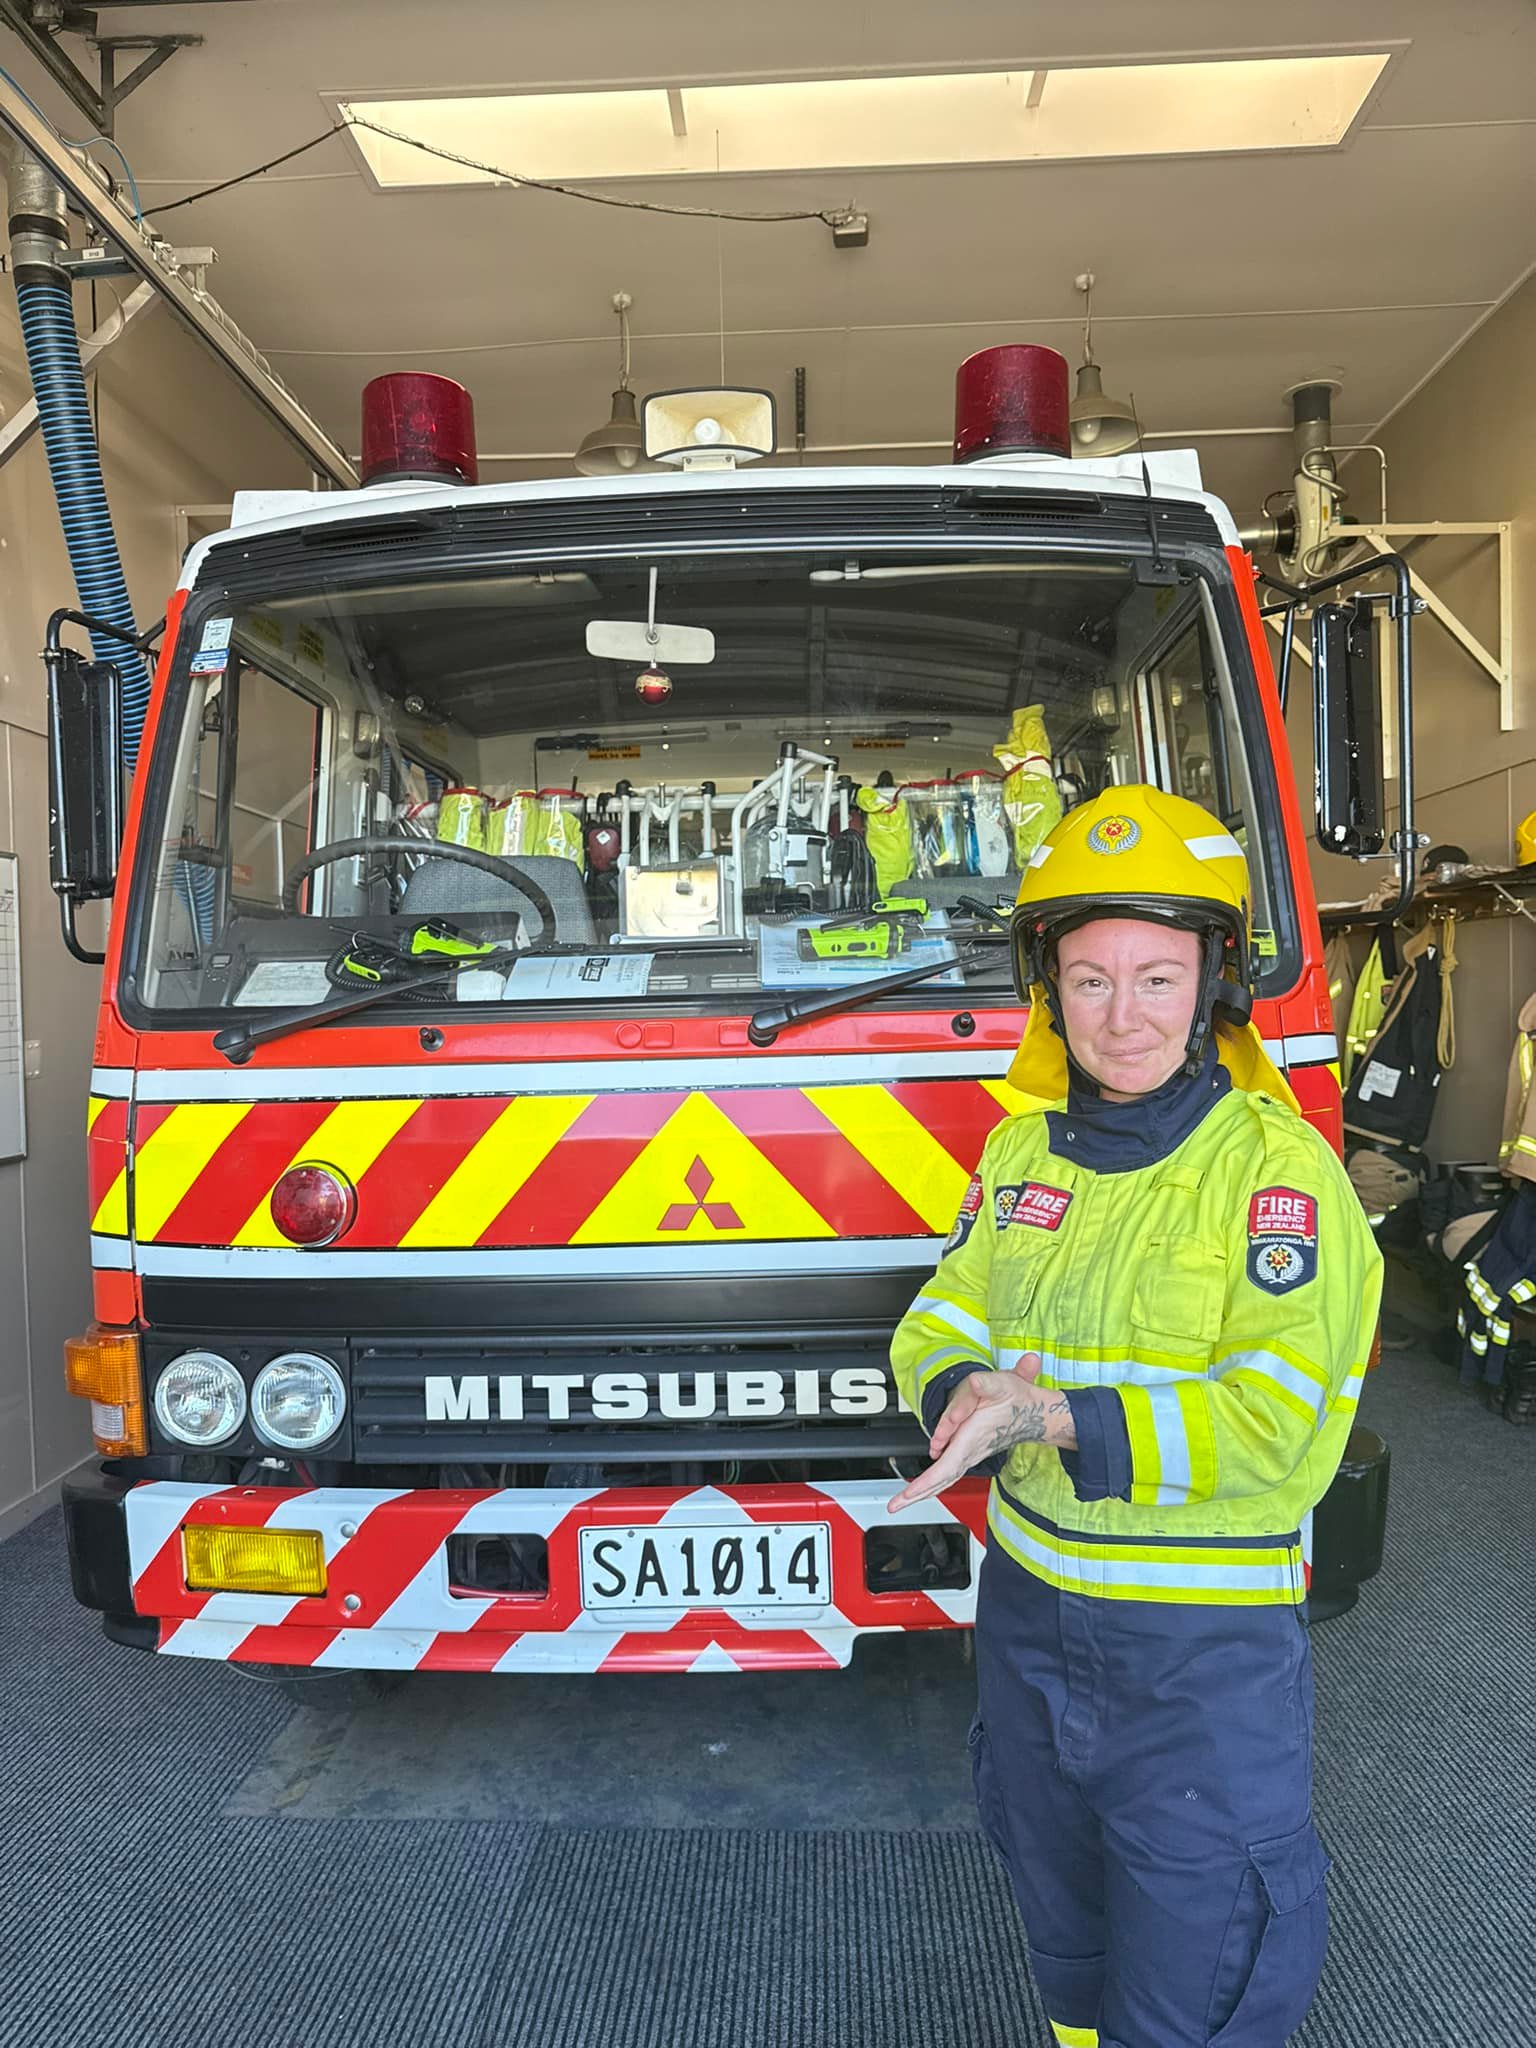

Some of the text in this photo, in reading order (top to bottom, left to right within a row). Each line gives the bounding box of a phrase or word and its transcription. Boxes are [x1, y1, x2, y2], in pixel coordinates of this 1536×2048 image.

[1018, 1189, 1068, 1214] FIRE
[1257, 1196, 1307, 1217] FIRE
[1257, 1214, 1306, 1223] EMERGENCY
[1271, 1222, 1306, 1231] ZEALAND
[424, 1369, 912, 1421] MITSUBIS
[592, 1534, 820, 1598] SA1014
